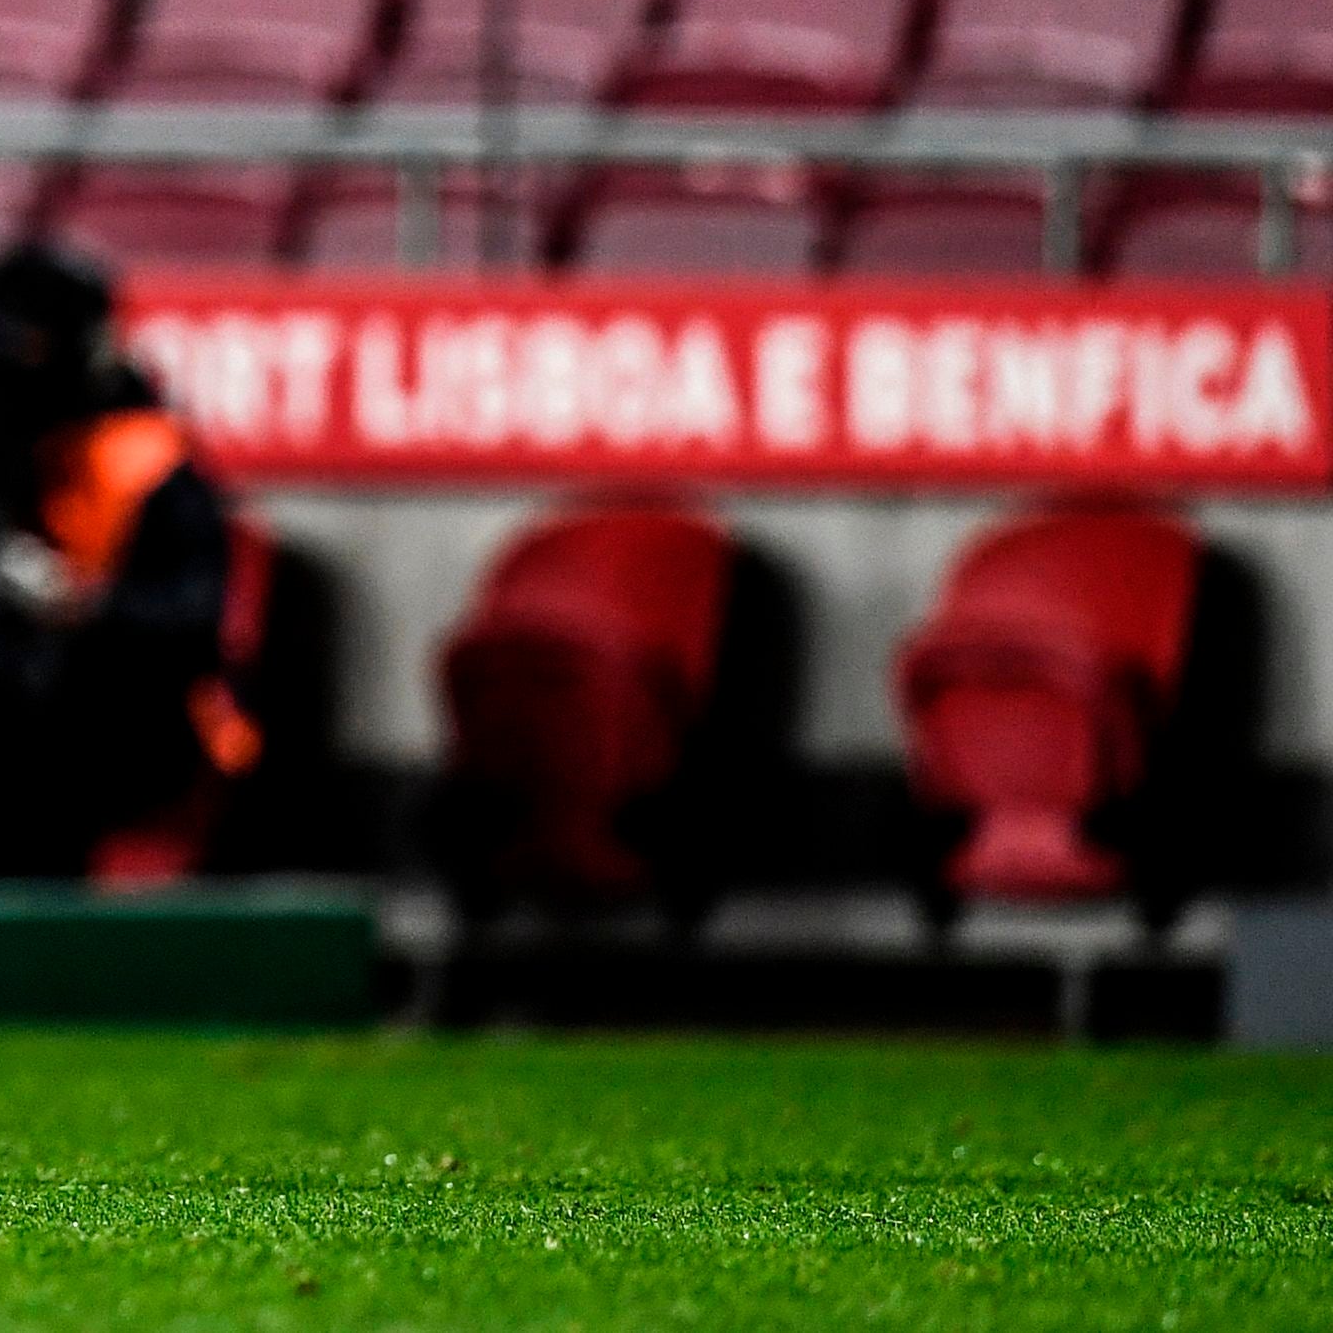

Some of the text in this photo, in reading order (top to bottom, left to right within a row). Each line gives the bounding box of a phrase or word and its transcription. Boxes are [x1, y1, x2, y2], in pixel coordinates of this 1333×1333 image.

[353, 313, 735, 447] LISBOA
[753, 313, 829, 449] E
[843, 315, 1311, 453] BENFICA
